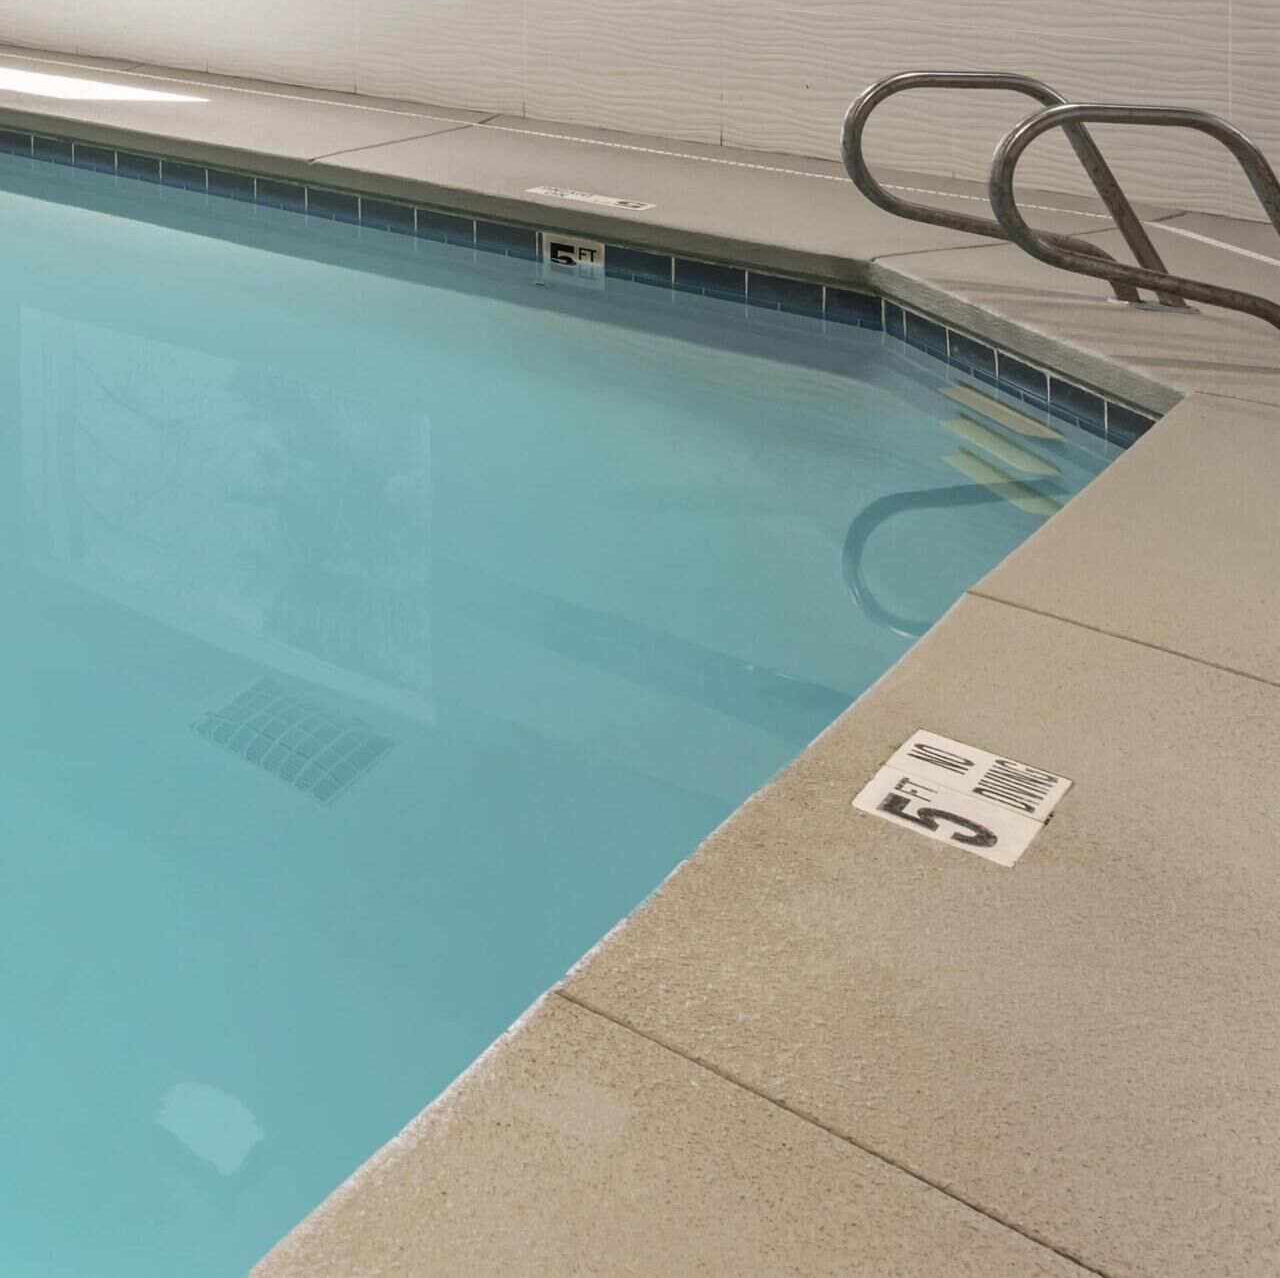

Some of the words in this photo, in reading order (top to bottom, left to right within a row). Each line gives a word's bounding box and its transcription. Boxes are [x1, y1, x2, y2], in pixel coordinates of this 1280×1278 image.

[550, 242, 577, 266] 5
[579, 248, 597, 263] FT
[907, 743, 975, 775] NO
[894, 777, 939, 803] FT
[972, 759, 1058, 814] DIVING
[876, 792, 998, 848] 5
